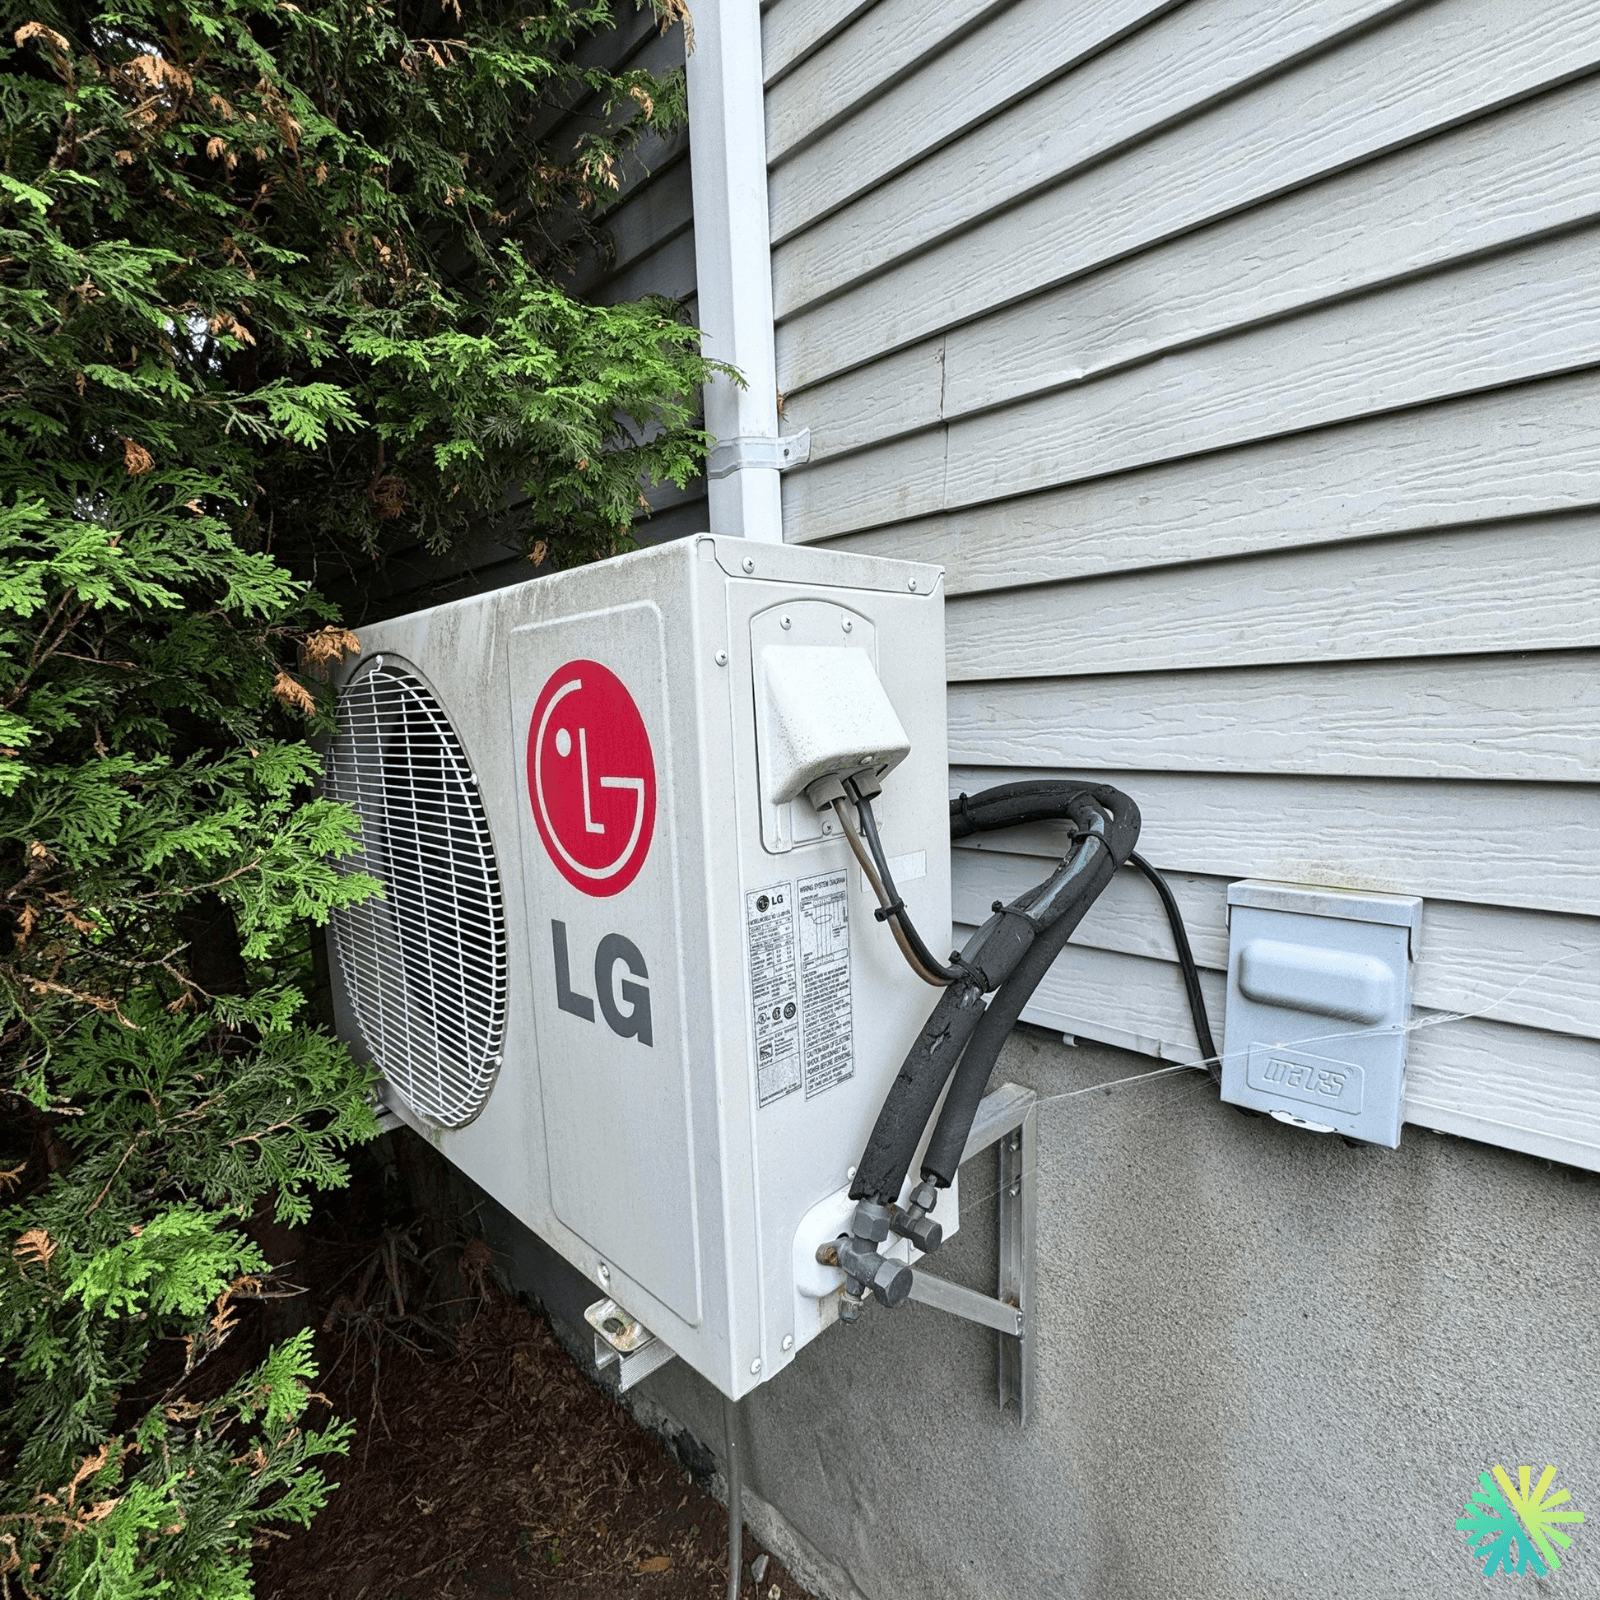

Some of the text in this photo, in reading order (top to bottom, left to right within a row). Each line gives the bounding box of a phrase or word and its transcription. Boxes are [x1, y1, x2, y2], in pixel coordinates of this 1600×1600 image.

[814, 881, 828, 889] SYSTEM
[772, 895, 783, 905] LG
[551, 919, 654, 1048] LG
[807, 1064, 819, 1075] POWER
[820, 1058, 833, 1069] BEFORE
[1262, 1058, 1347, 1098] mars
